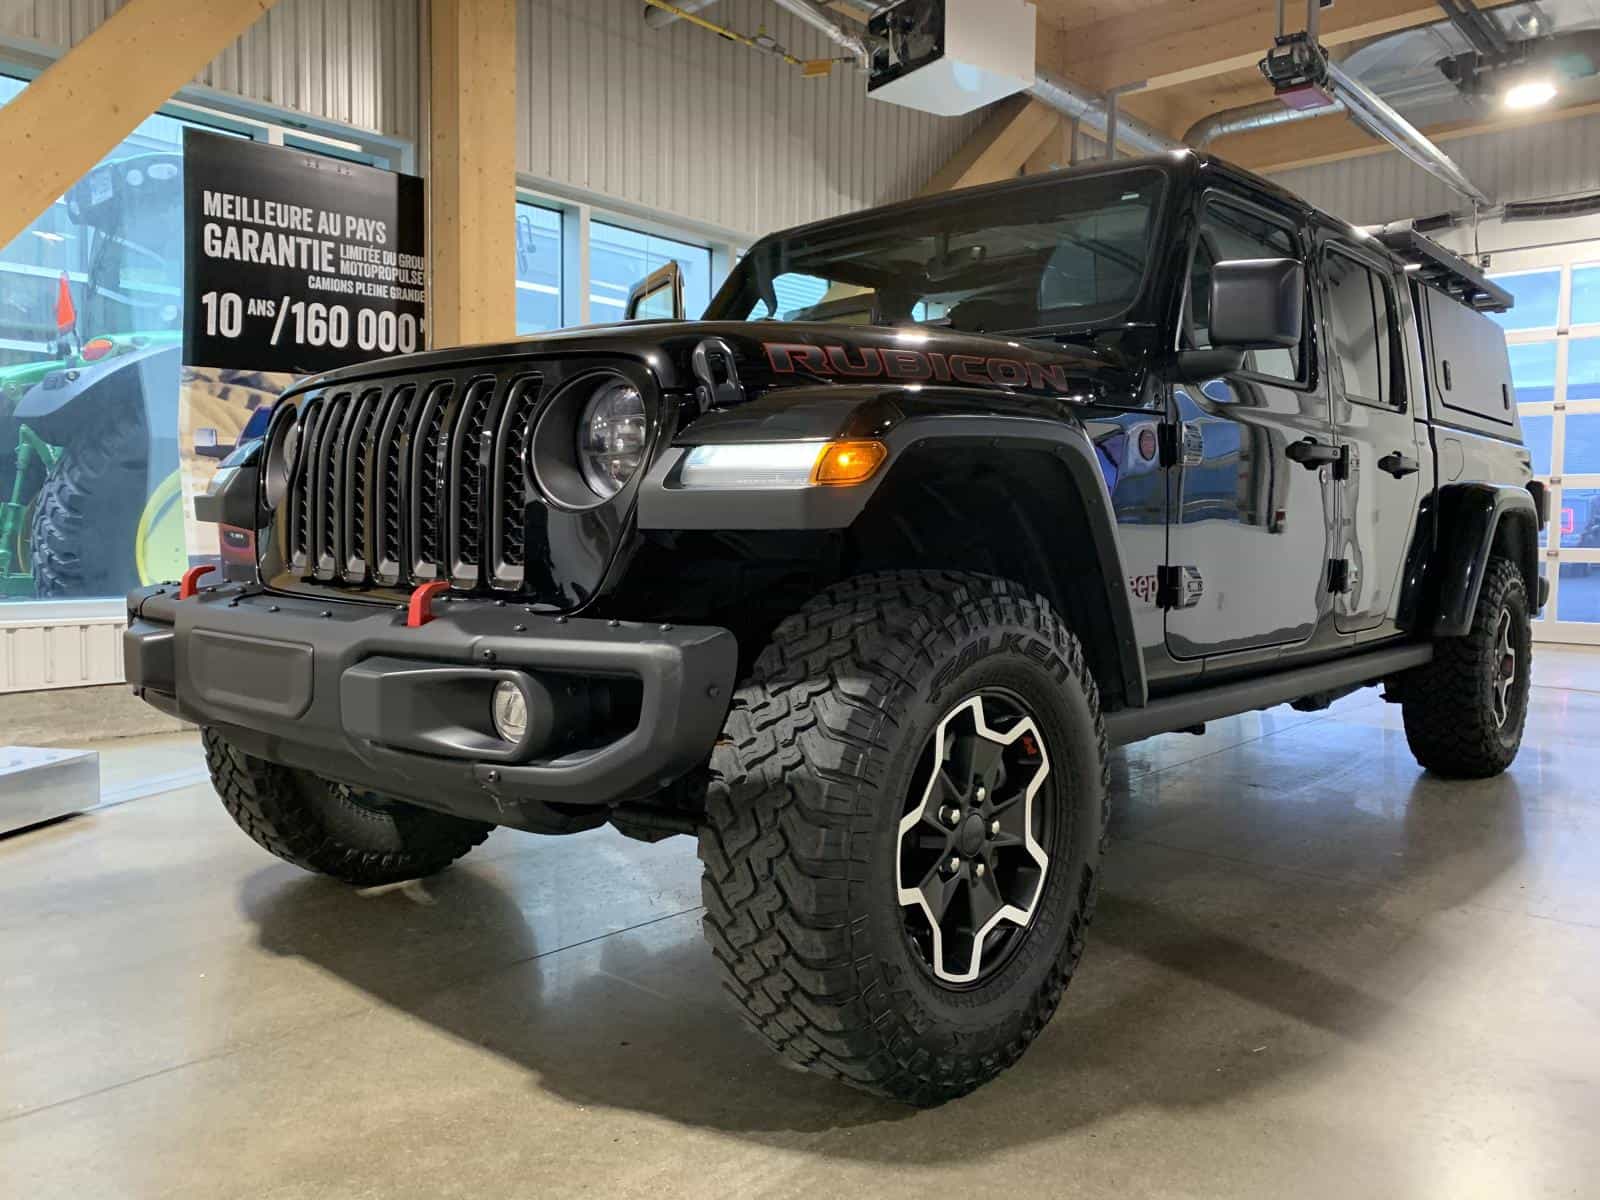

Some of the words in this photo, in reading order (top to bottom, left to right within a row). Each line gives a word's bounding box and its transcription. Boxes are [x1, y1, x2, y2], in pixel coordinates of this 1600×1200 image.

[203, 190, 314, 233] MEILLEURE
[317, 211, 341, 237] AU
[345, 215, 387, 245] PAYS
[203, 222, 335, 274] GARANTIE
[340, 243, 381, 264] LIMITÉE
[383, 251, 397, 267] DU
[308, 275, 354, 294] CAMIONS
[355, 283, 389, 299] PLEINE
[390, 286, 425, 305] GRANDE
[202, 291, 243, 338] 10
[763, 342, 1069, 392] RUBICON
[1125, 576, 1159, 602] eep
